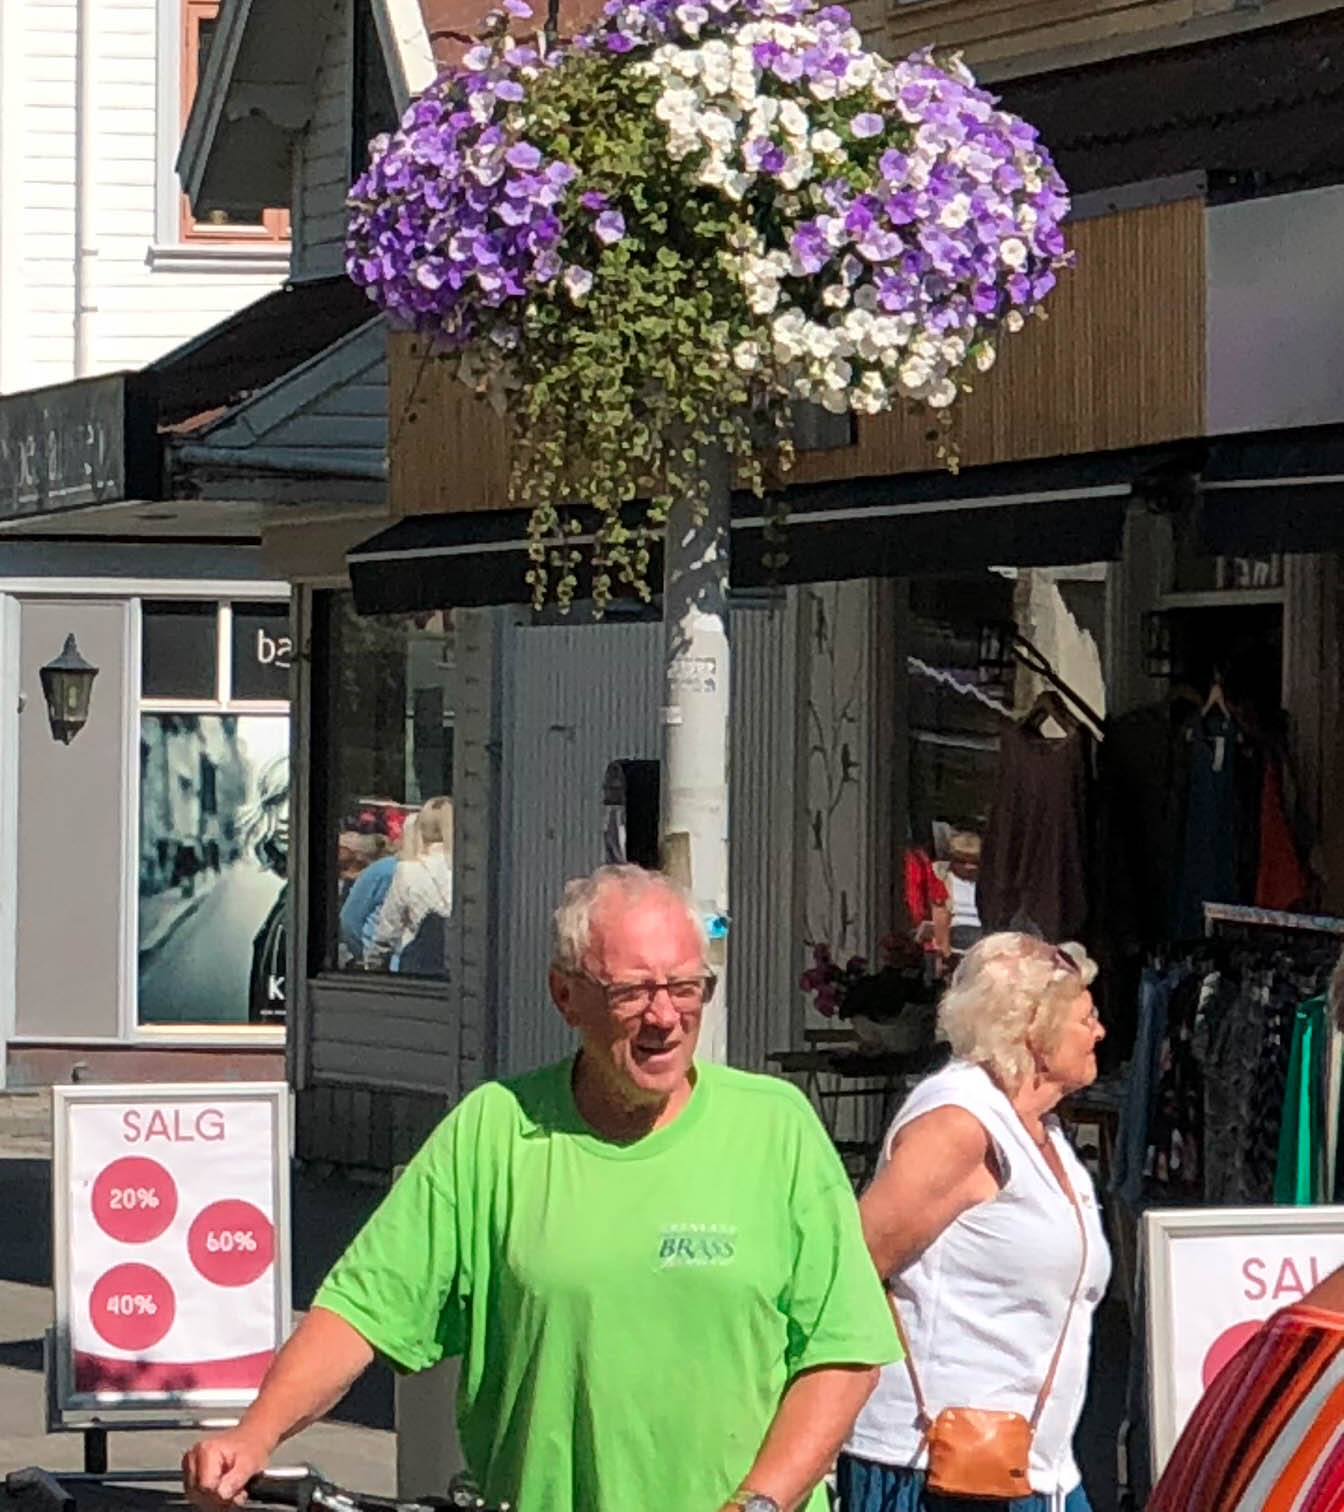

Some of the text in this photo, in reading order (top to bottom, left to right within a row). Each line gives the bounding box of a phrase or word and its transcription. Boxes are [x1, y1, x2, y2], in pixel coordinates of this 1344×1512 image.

[123, 1109, 226, 1142] SALG
[110, 1188, 160, 1210] 20%
[206, 1231, 257, 1252] 60%
[659, 1237, 735, 1260] BRASS
[106, 1293, 158, 1316] 40%
